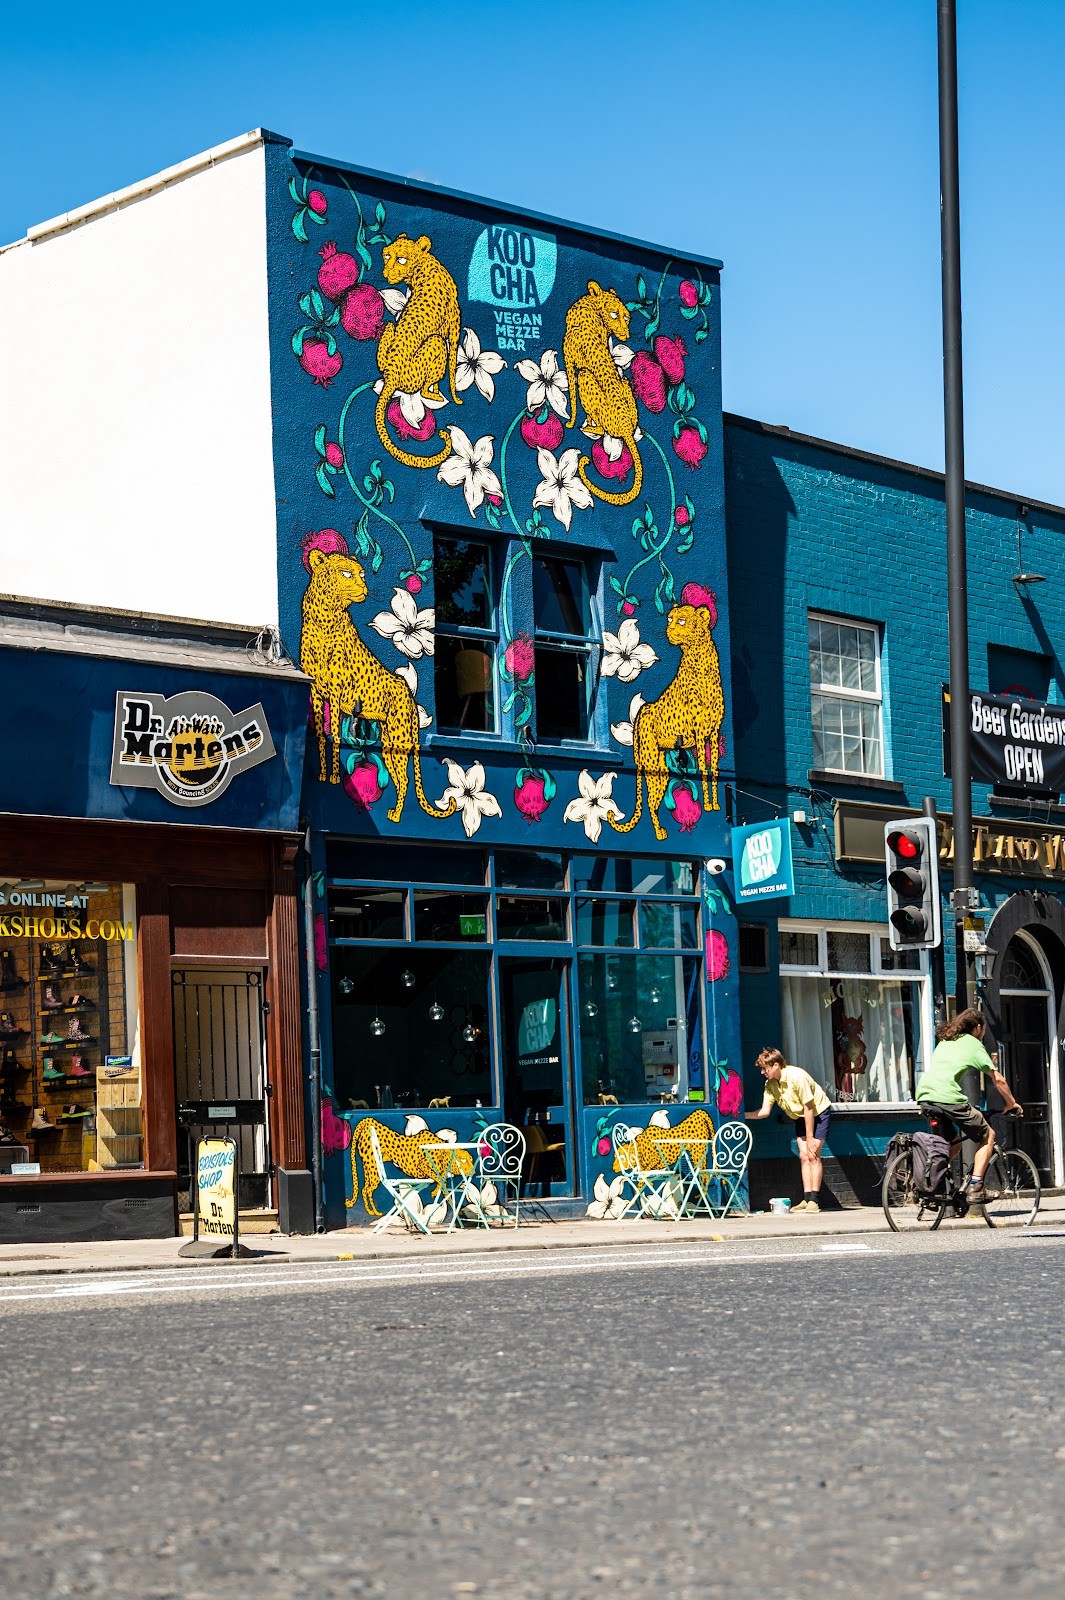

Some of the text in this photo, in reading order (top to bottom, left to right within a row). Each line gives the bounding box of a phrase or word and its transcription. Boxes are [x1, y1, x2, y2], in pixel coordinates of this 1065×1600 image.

[487, 225, 536, 269] KOO
[490, 263, 540, 305] CHA
[494, 311, 542, 326] VEGAN
[496, 324, 540, 339] MEZZE
[498, 337, 526, 351] BAR
[125, 702, 162, 733] Dr.
[972, 696, 1007, 736] Beer
[122, 724, 261, 765] Martens
[1004, 744, 1044, 784] OPEN
[746, 832, 773, 861] KOO
[749, 854, 777, 882] CHA
[9, 893, 66, 908] ONLINE
[71, 895, 89, 908] AT
[740, 883, 787, 896] VEGAN MEZZE BAR
[523, 1002, 547, 1028] KOO
[526, 1025, 551, 1050] CHA
[199, 1170, 222, 1189] SHOP
[210, 1202, 224, 1218] Dr.
